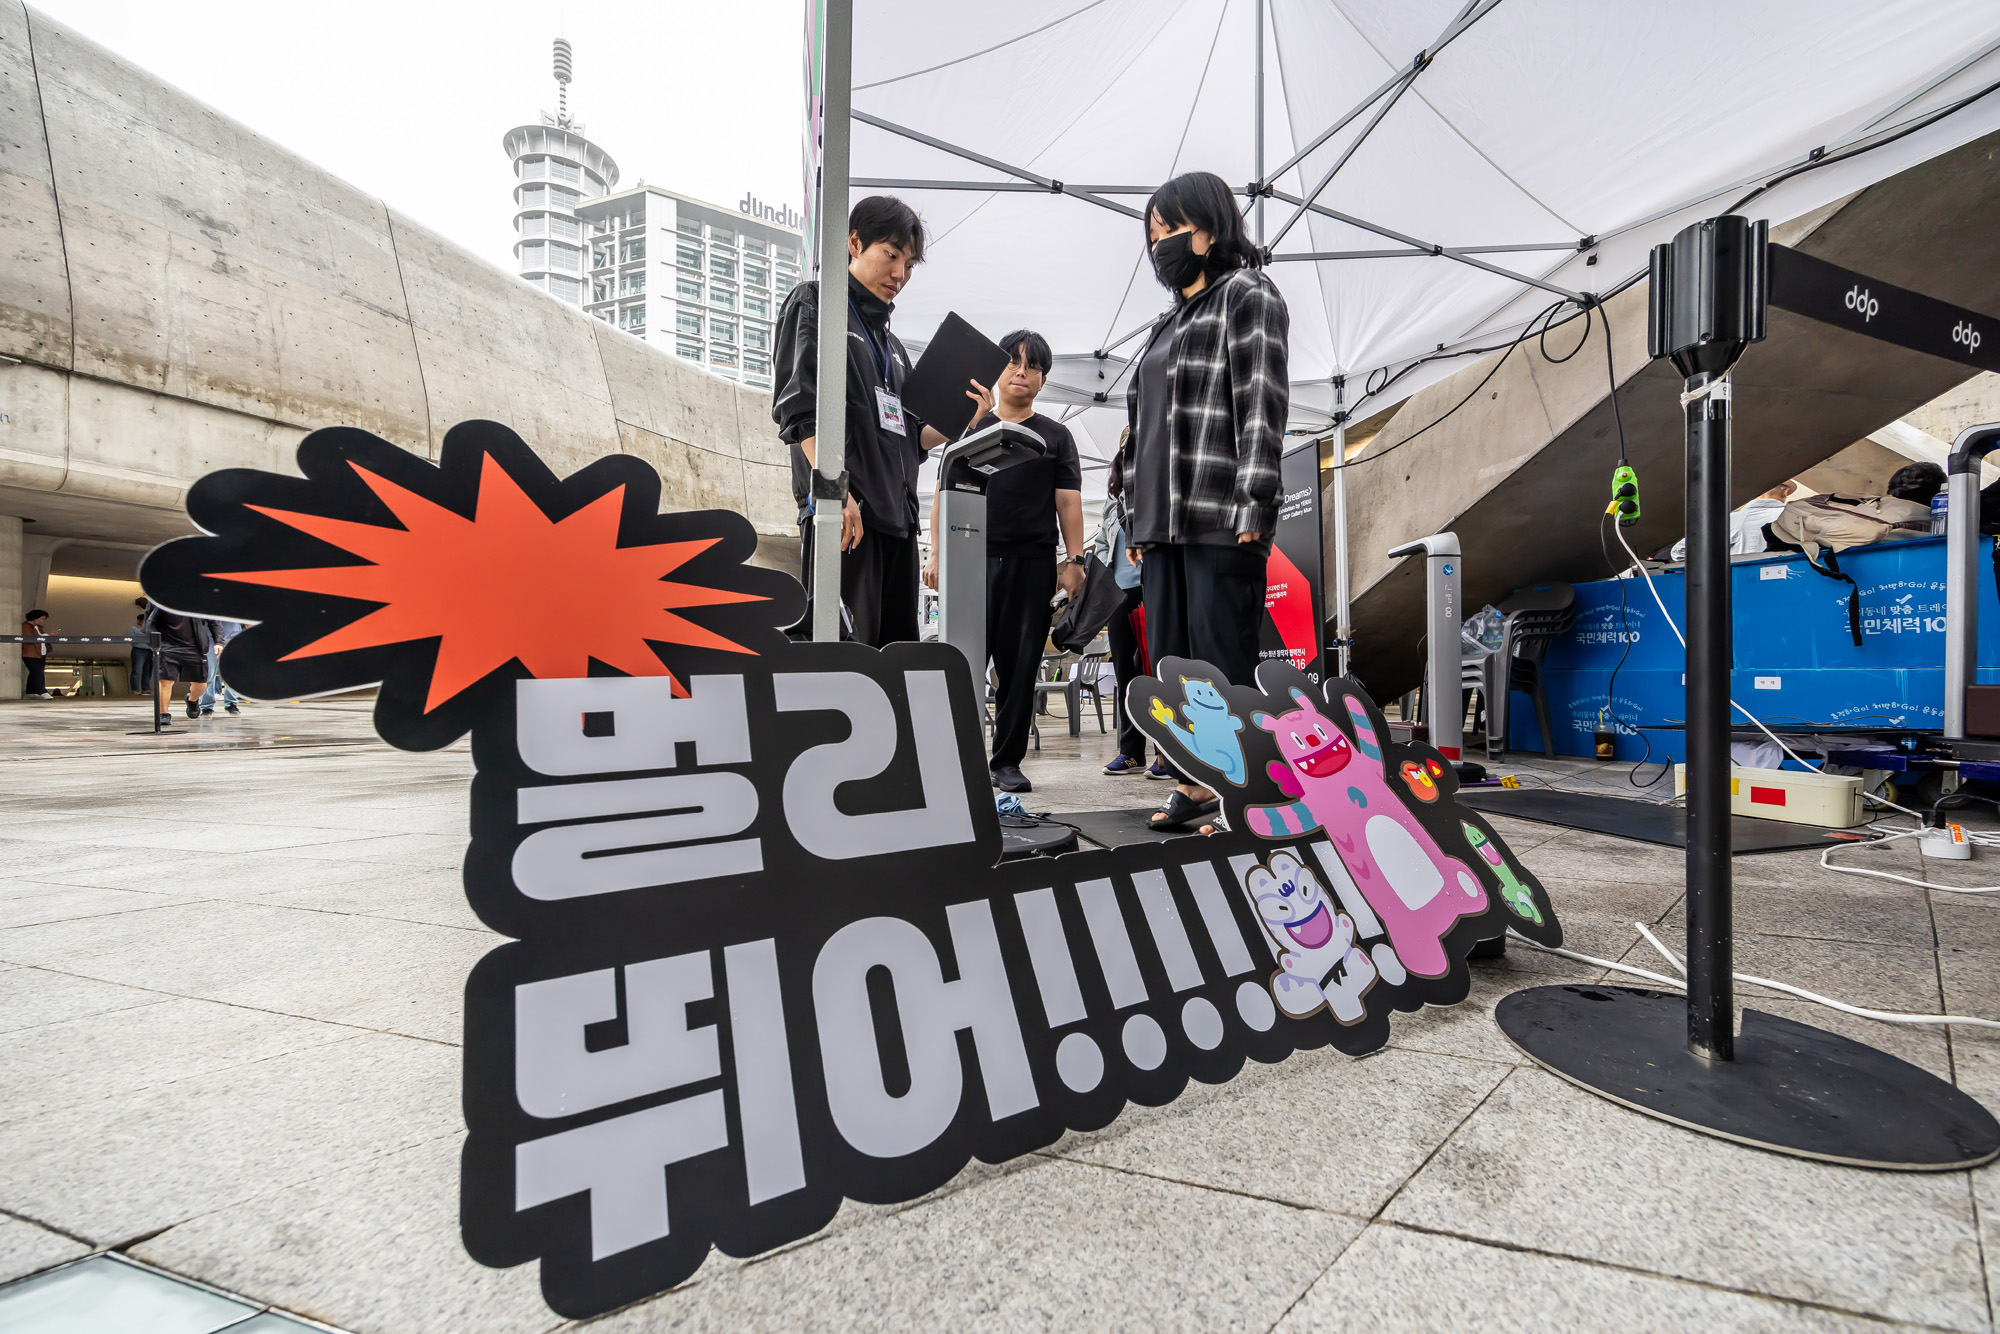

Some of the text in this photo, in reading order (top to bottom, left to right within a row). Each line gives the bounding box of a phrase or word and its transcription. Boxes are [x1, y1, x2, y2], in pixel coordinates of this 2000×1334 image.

[1845, 284, 1878, 322] ddp
[1952, 320, 1981, 354] ddp
[1890, 605, 1914, 615] 맞춤
[1576, 631, 1640, 645] 국민체력100
[1572, 720, 1638, 736] 국민100
[511, 670, 976, 900] 멀리
